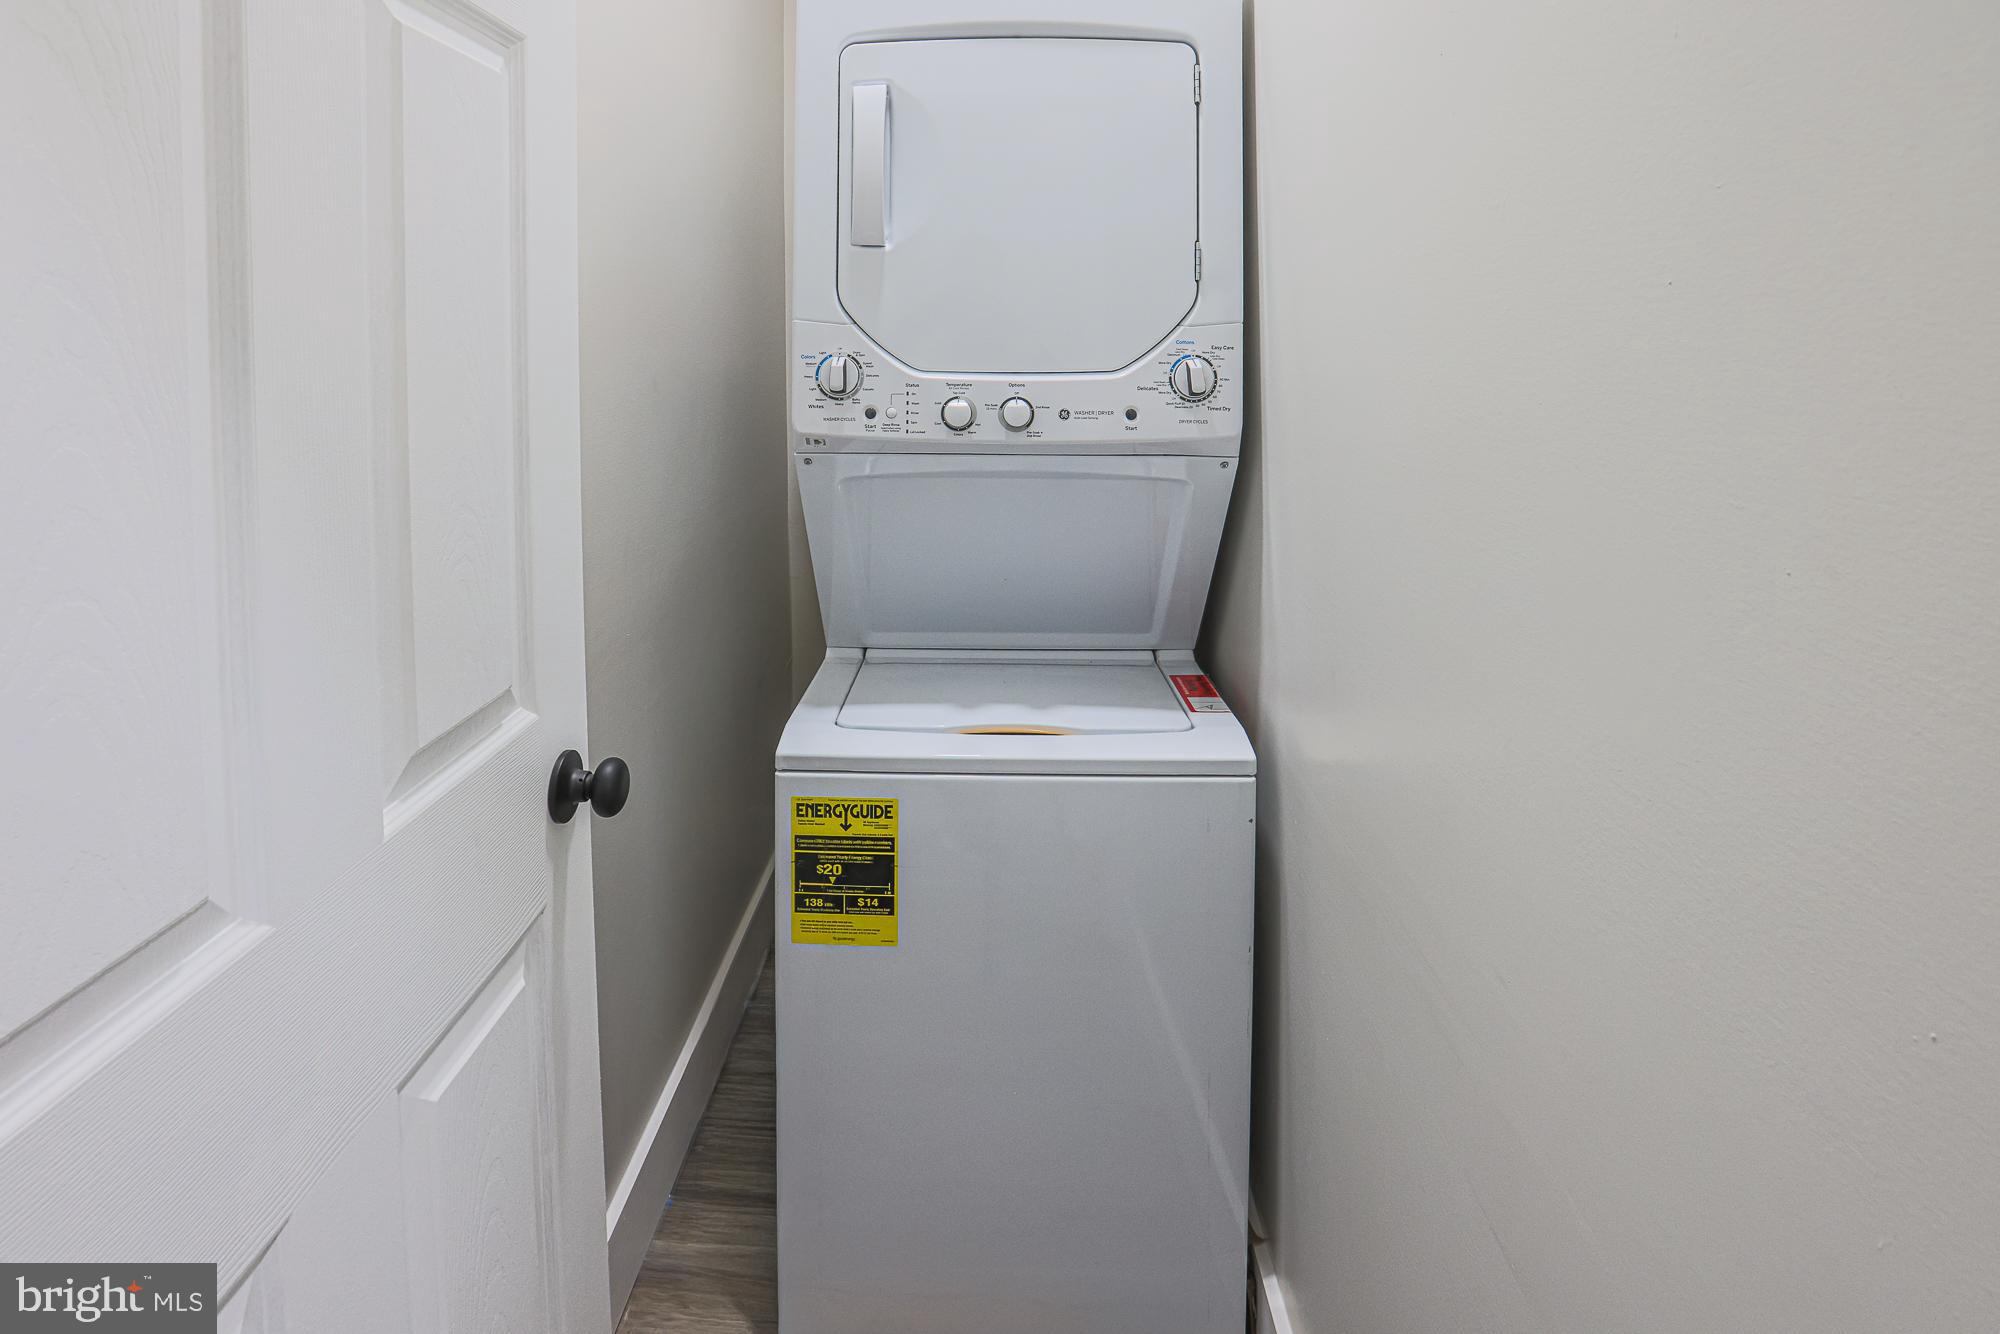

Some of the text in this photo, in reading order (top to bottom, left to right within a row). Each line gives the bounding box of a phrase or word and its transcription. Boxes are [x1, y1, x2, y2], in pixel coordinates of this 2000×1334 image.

[796, 803, 893, 819] ENERGYGUIDE
[816, 864, 842, 876] $20
[804, 898, 823, 906] 138
[858, 898, 878, 906] $14
